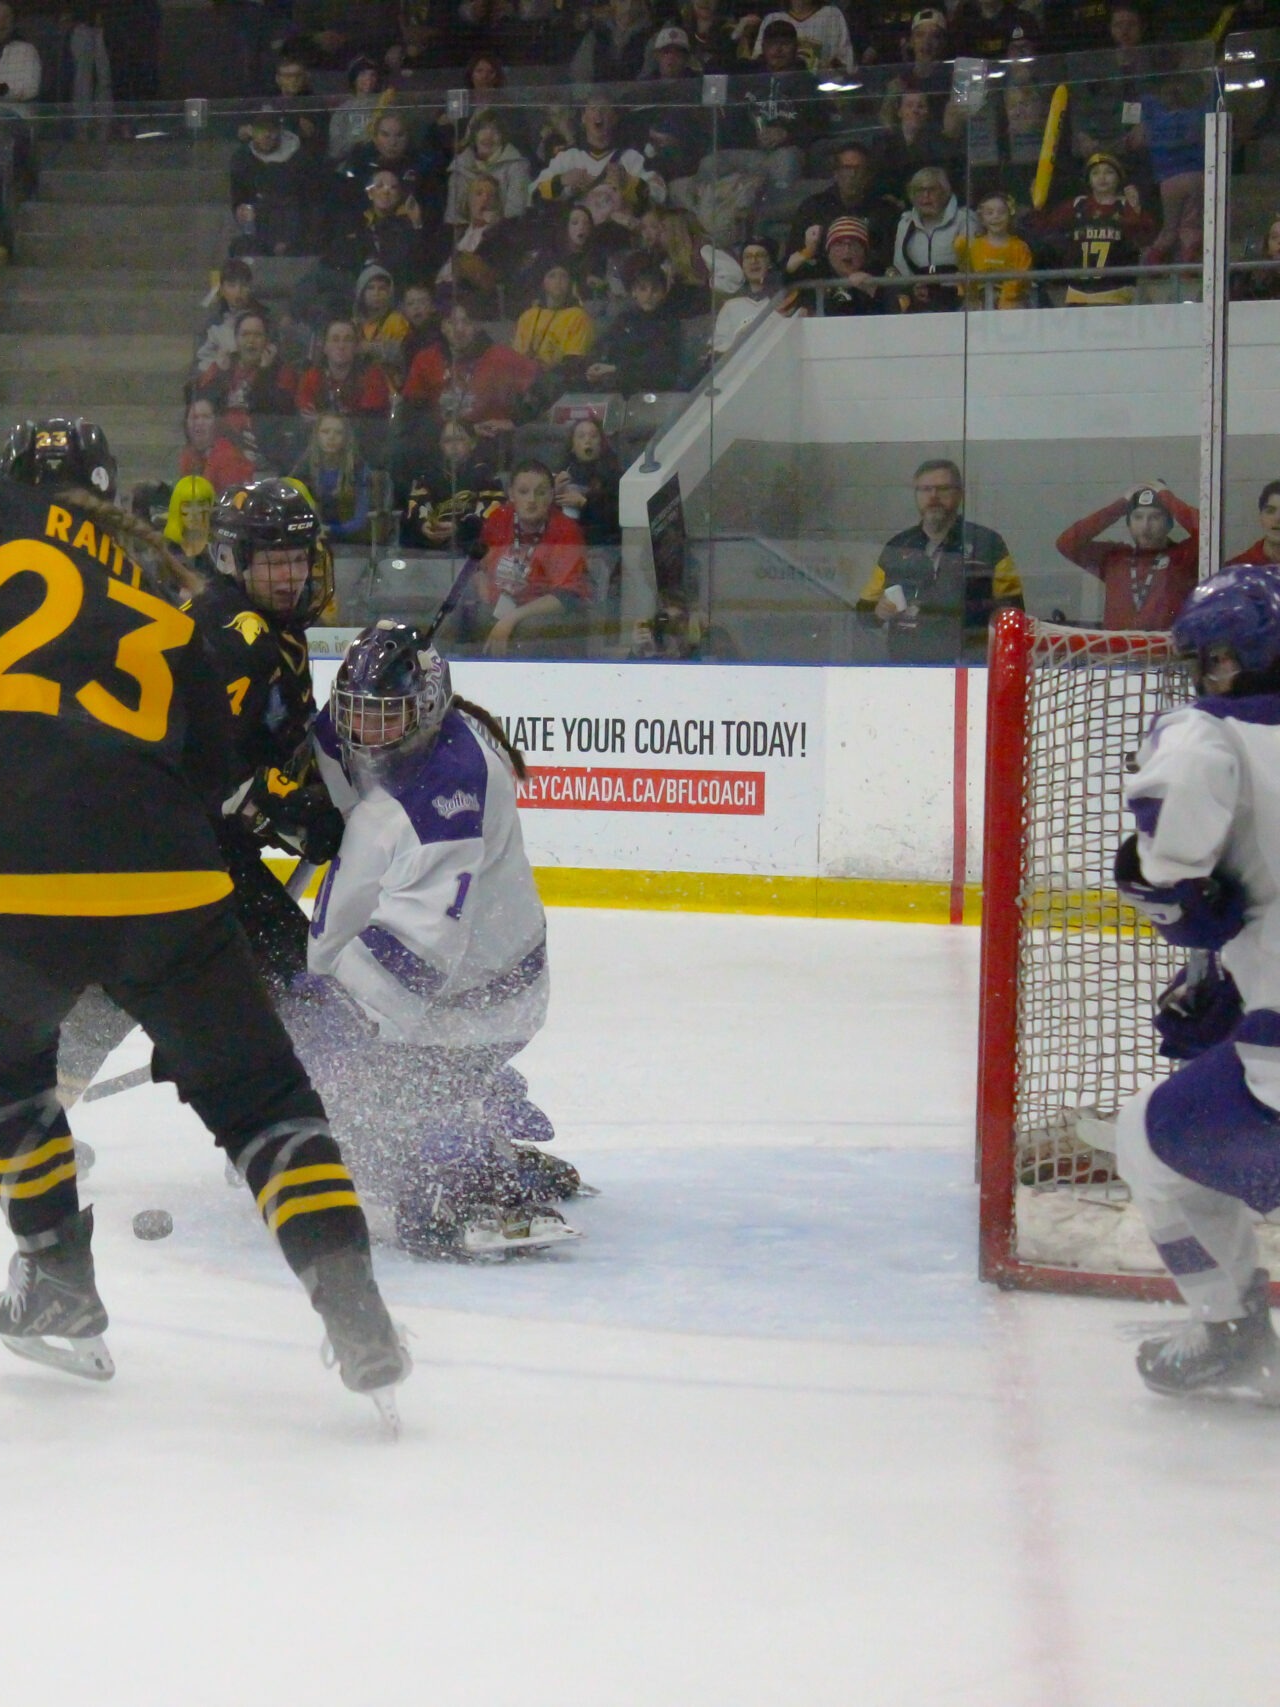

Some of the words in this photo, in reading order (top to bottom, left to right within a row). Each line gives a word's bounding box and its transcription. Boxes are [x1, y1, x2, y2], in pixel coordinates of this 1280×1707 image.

[1080, 241, 1111, 280] 17
[35, 430, 67, 448] 23
[287, 521, 314, 532] CCM
[44, 504, 143, 590] RAITT
[495, 716, 555, 752] NATE
[562, 718, 626, 753] YOUR
[634, 718, 715, 756] COACH
[721, 720, 808, 758] TODAY!
[515, 774, 757, 806] KEYCANADA.CA/BFLCOACH
[445, 871, 473, 921] 1
